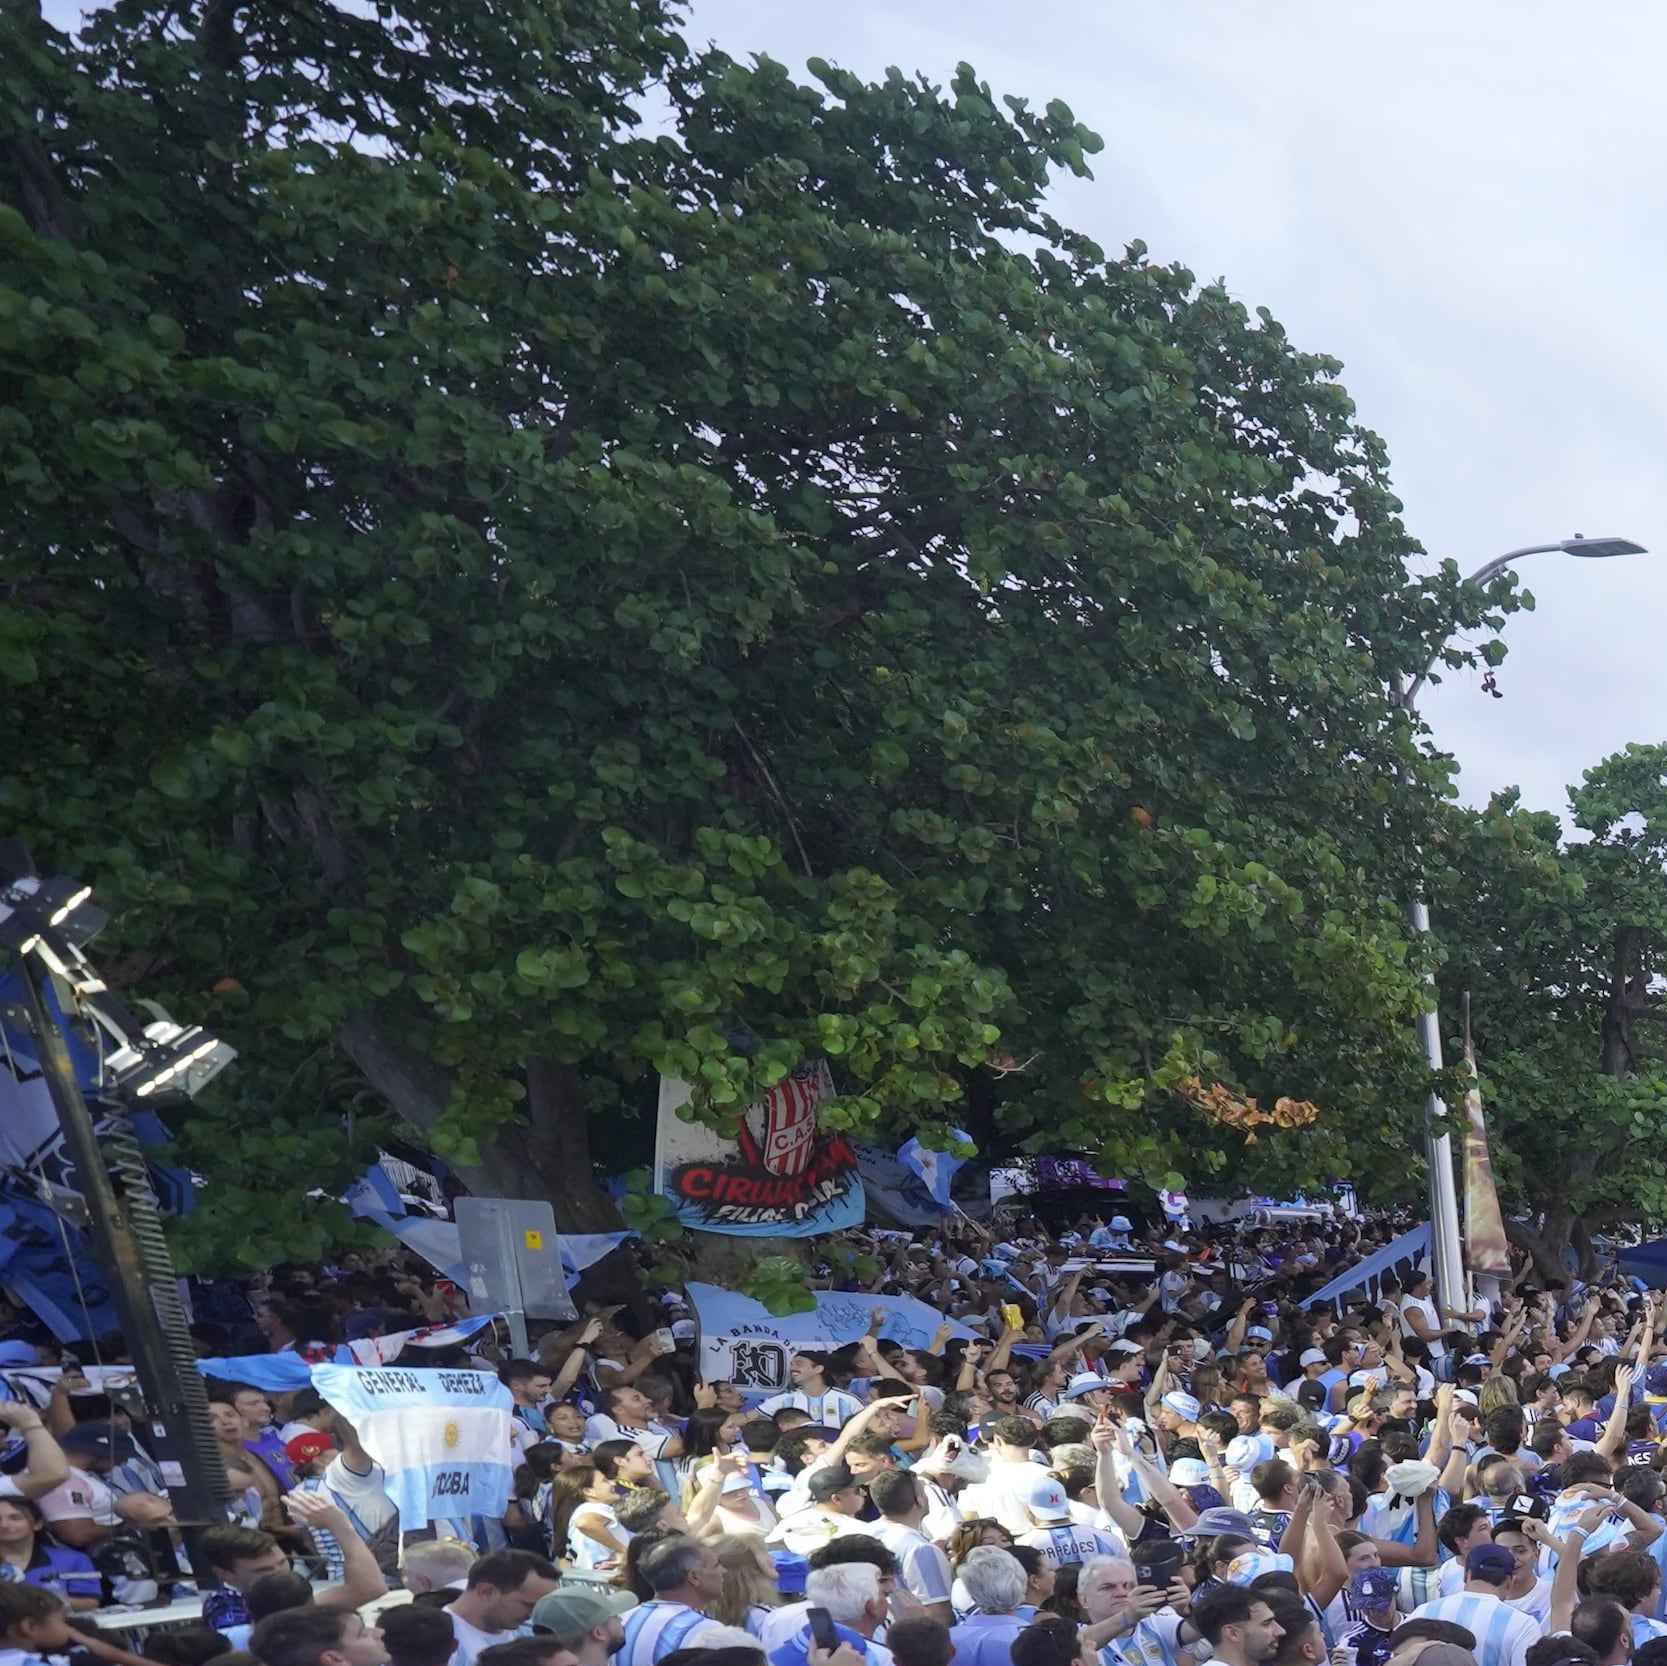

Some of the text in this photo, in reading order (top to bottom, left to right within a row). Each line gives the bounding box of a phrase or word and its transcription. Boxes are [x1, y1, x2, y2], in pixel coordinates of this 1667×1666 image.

[710, 1336, 728, 1353] LA
[729, 1323, 780, 1340] BANDA
[356, 1371, 427, 1395] GENERAL
